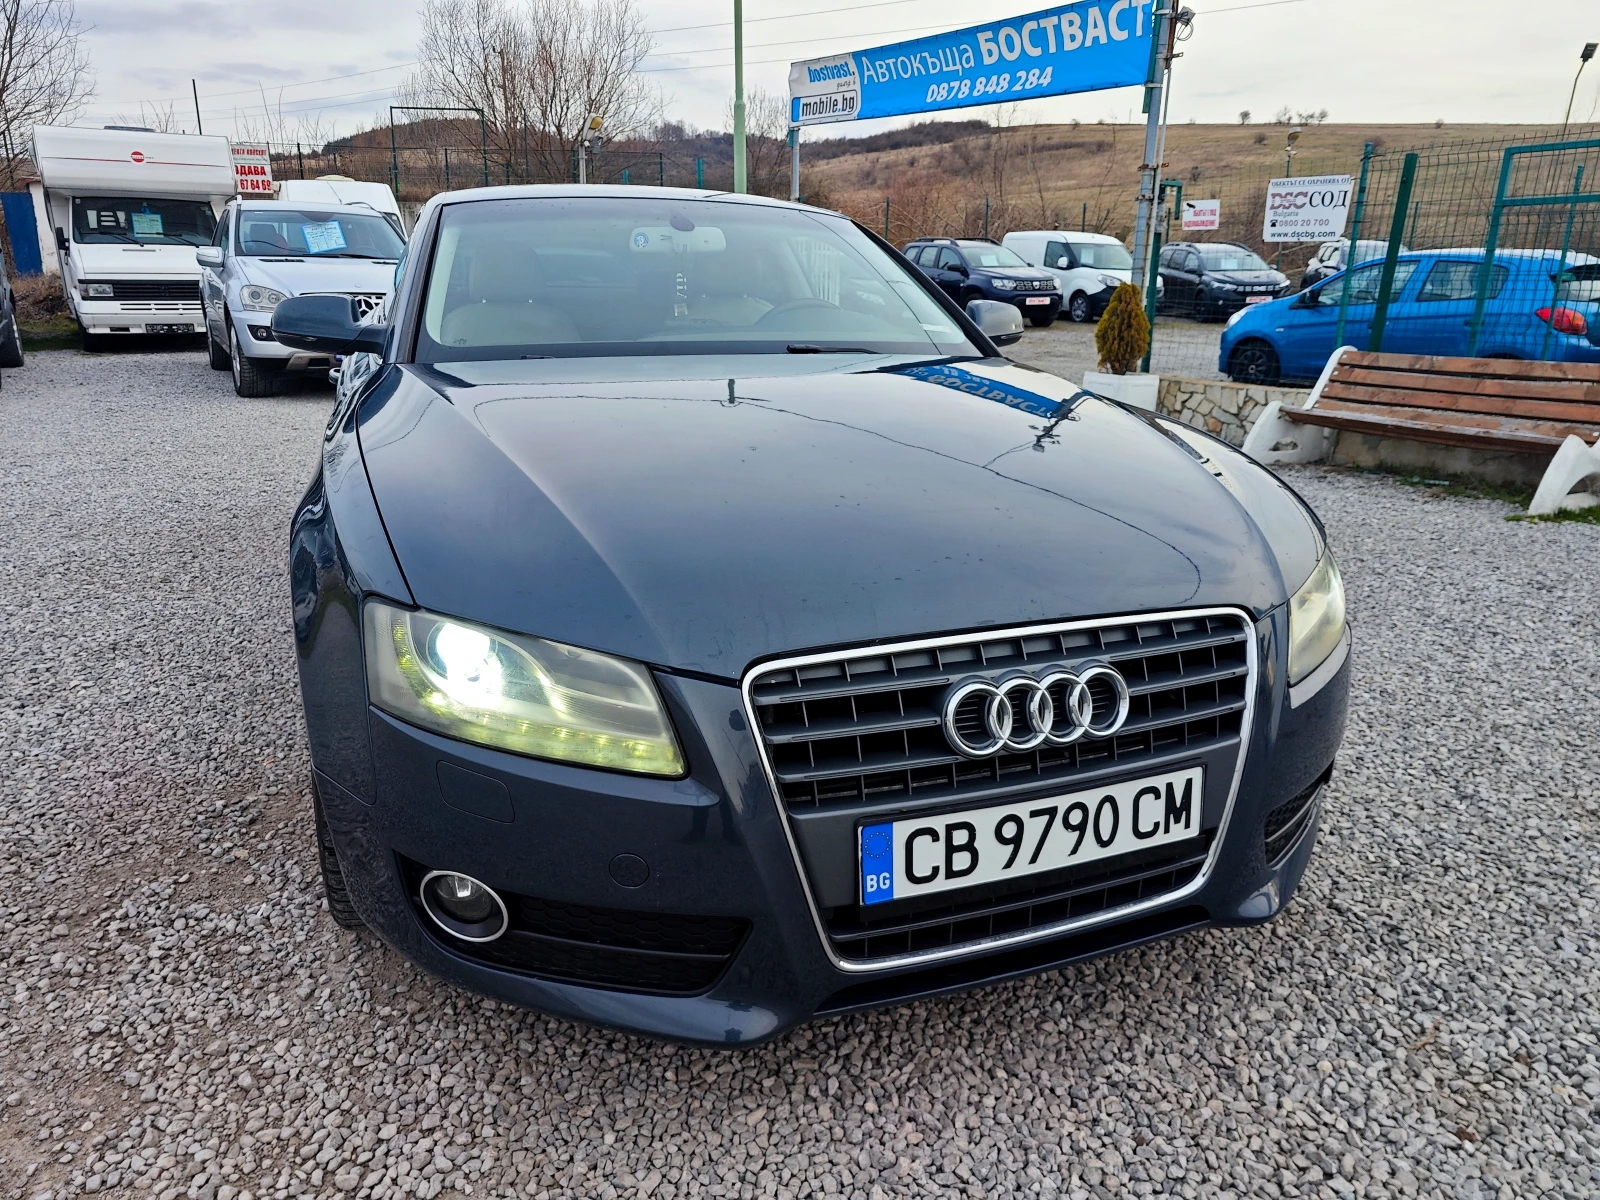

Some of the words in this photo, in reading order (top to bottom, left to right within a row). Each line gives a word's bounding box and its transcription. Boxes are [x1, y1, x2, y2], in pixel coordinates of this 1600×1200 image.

[862, 44, 975, 84] Автокъща
[977, 0, 1151, 66] БОСТВАСТ
[925, 81, 973, 103] 0878
[973, 72, 1010, 98] 848
[1010, 66, 1053, 93] 284
[801, 94, 855, 117] mobile.bg
[1309, 190, 1349, 210] СОД
[1272, 210, 1299, 218] Bulgaria
[1279, 219, 1299, 227] 0800
[1300, 219, 1311, 227] 20
[1313, 218, 1330, 226] 700
[1270, 230, 1336, 239] www.dscbg.com
[904, 820, 979, 885] CB
[994, 794, 1120, 870] 9790
[1132, 777, 1194, 840] CM
[866, 872, 890, 893] BG
